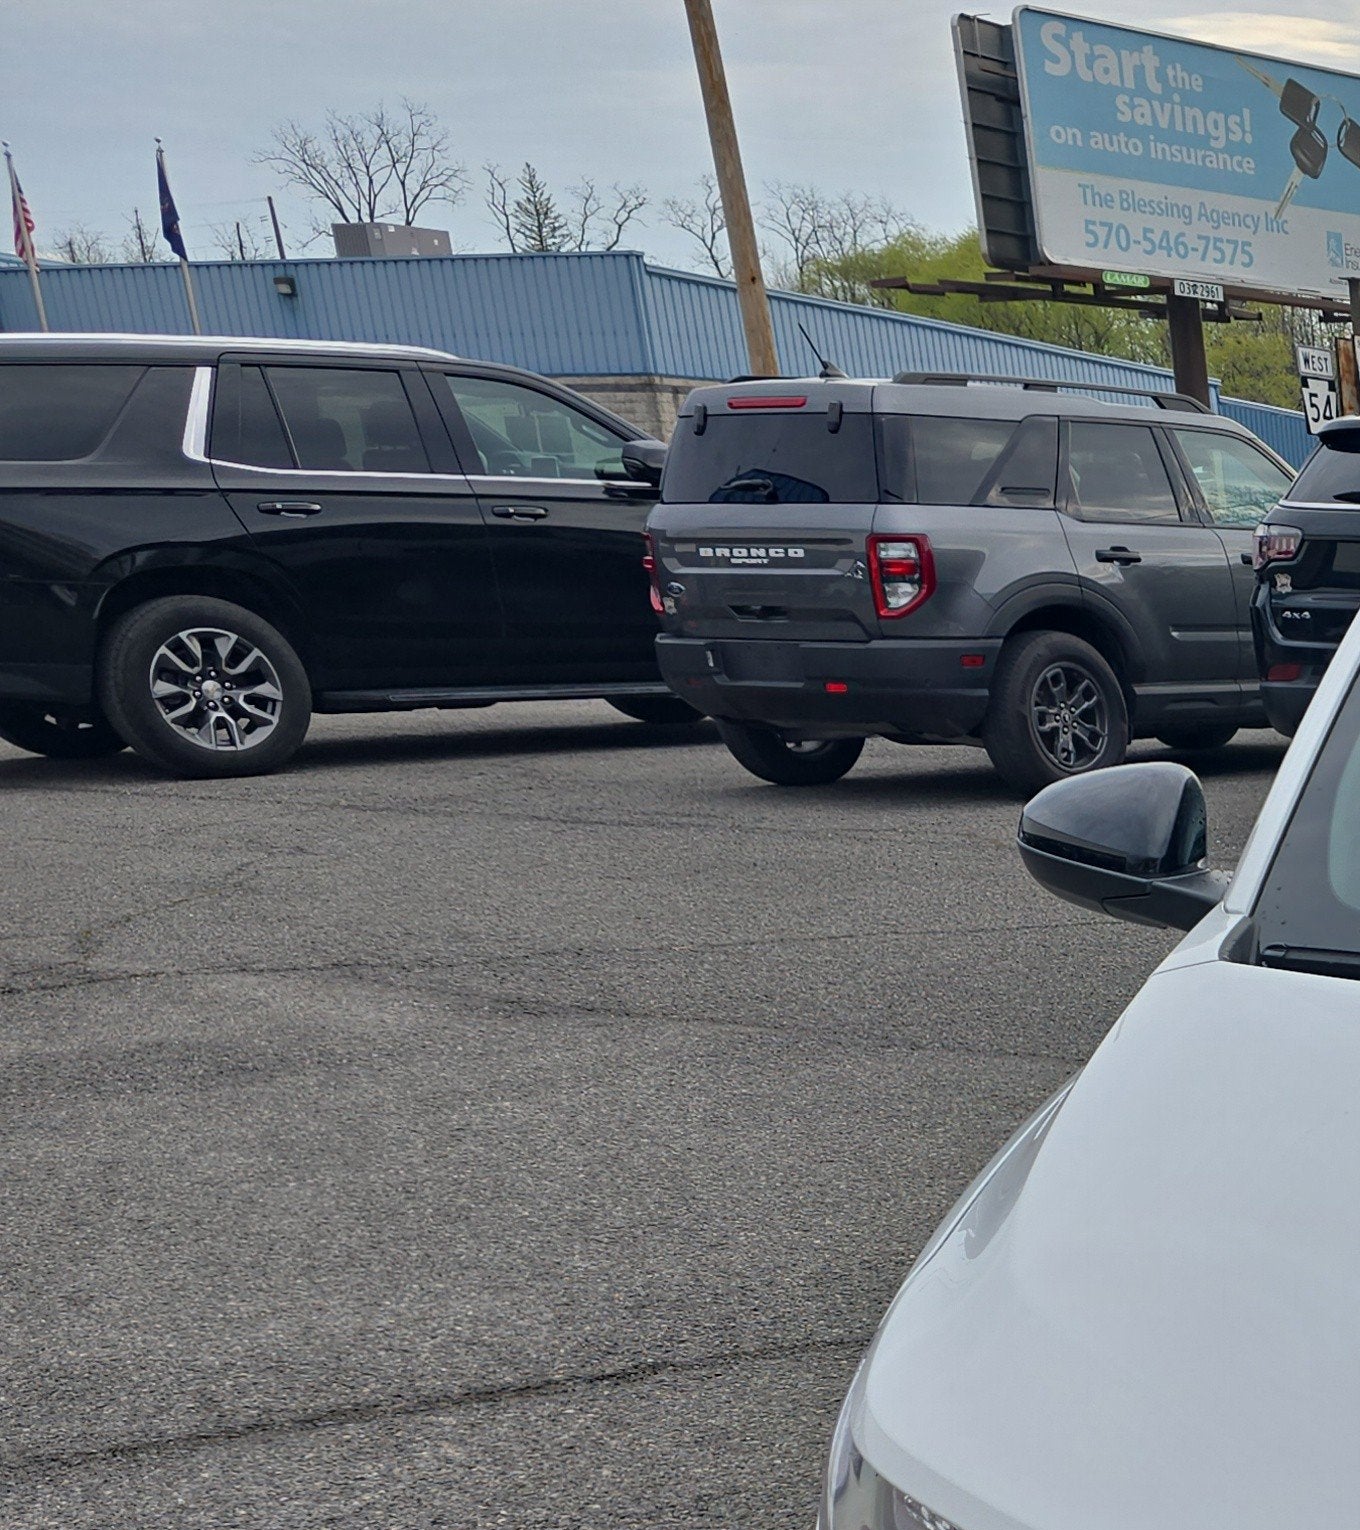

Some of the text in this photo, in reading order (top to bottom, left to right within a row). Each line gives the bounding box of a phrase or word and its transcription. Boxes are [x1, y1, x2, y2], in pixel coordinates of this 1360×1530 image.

[1040, 20, 1203, 94] Start the
[1115, 92, 1253, 149] savings!
[1050, 125, 1256, 175] on auto insurance
[1077, 183, 1290, 235] The Blessing Agency Inc
[1084, 218, 1254, 269] 570-546-7575
[1301, 350, 1329, 373] WEST
[1308, 392, 1334, 423] 54
[698, 547, 805, 558] BRONCO
